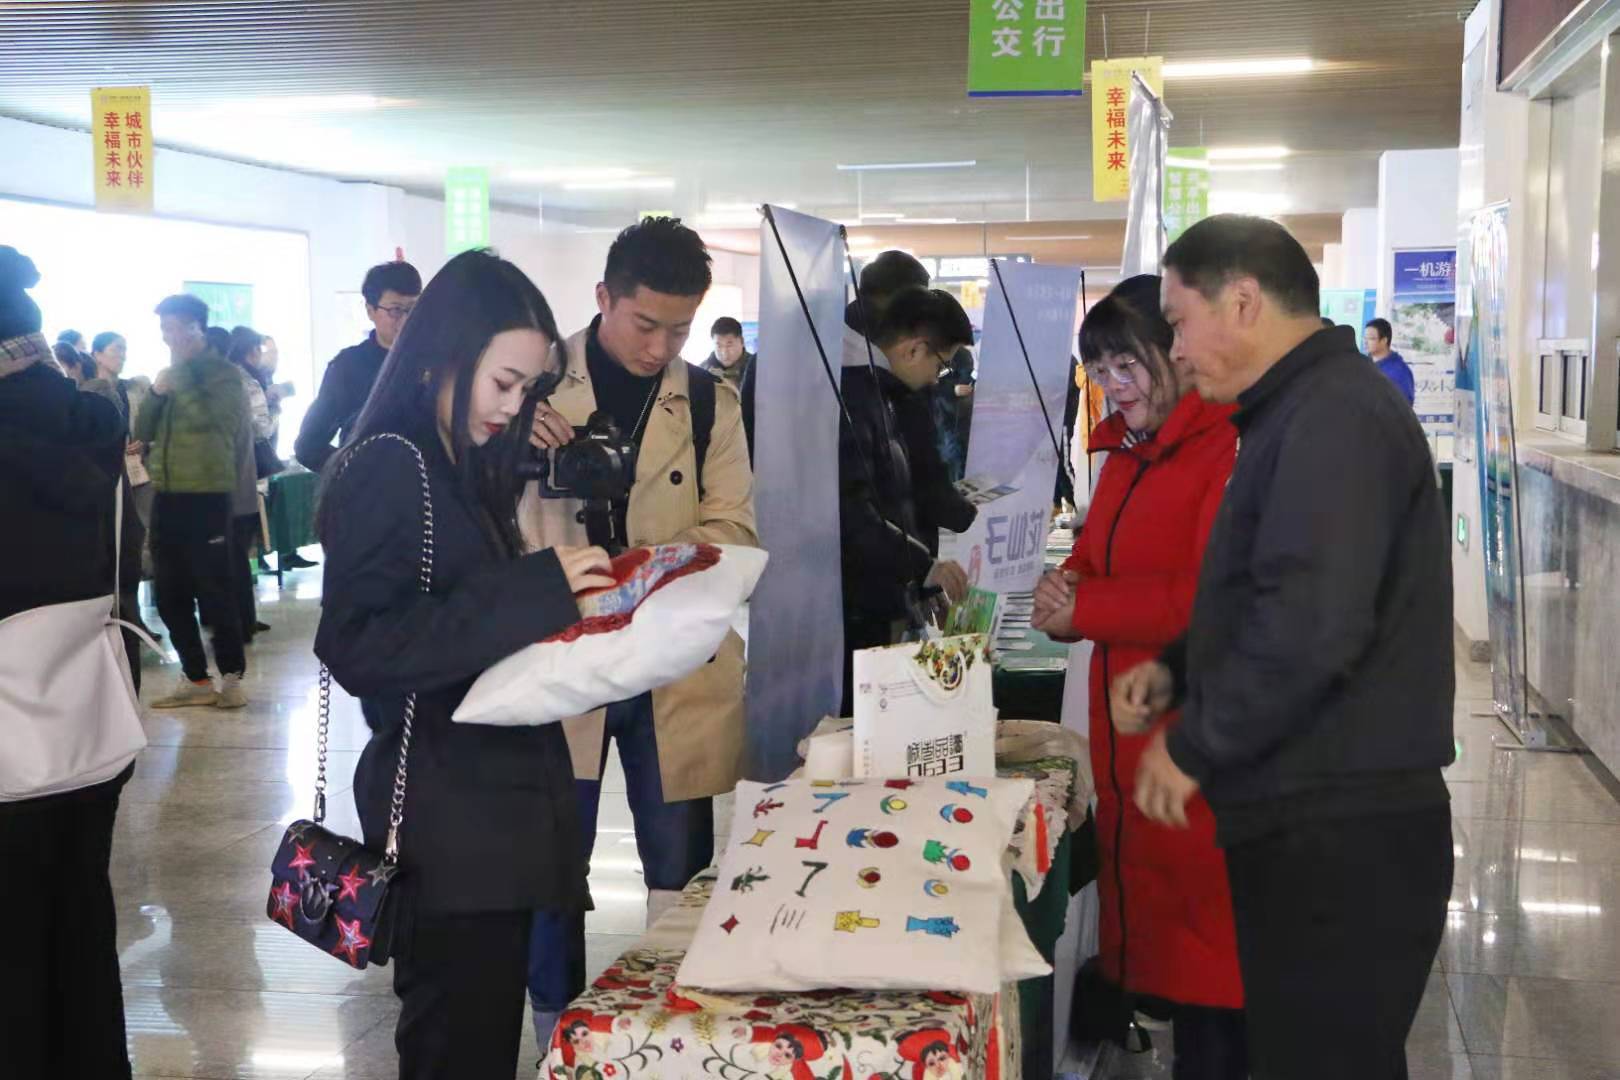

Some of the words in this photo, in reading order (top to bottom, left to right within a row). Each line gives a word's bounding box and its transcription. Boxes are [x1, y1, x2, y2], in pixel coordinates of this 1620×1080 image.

[104, 112, 121, 188] 幸福未来
[125, 112, 144, 188] 城市伙伴
[1106, 87, 1126, 171] 幸福未来
